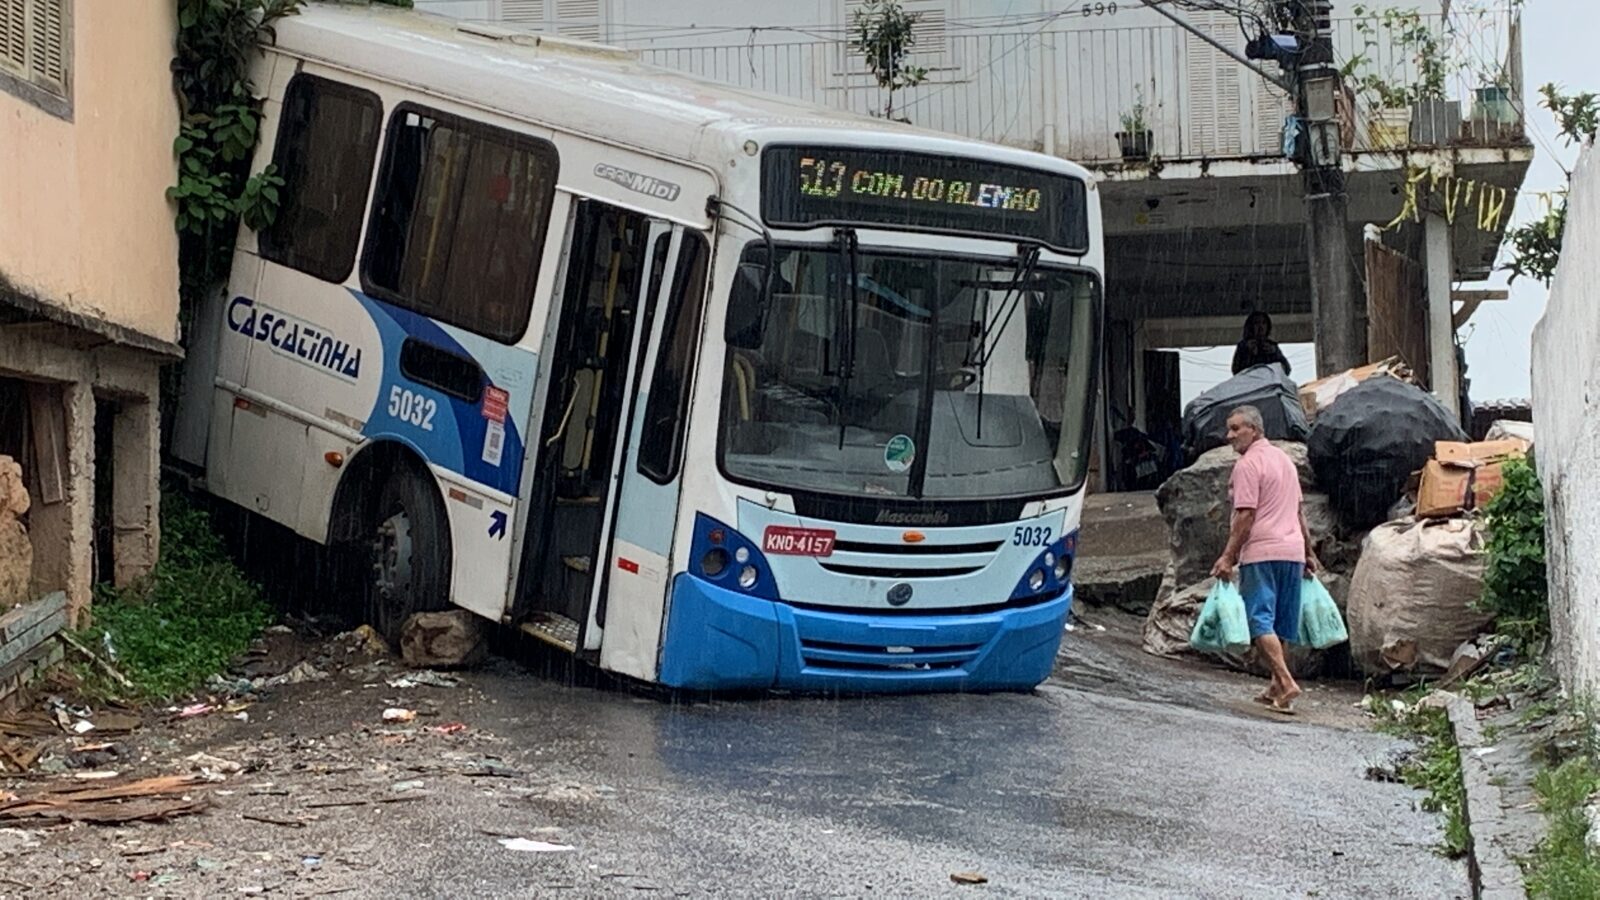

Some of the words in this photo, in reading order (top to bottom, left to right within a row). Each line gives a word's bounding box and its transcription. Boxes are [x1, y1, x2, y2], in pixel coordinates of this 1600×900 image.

[1081, 2, 1118, 17] 590
[800, 157, 846, 197] 513
[388, 384, 437, 432] 5032
[1013, 526, 1052, 547] 5032
